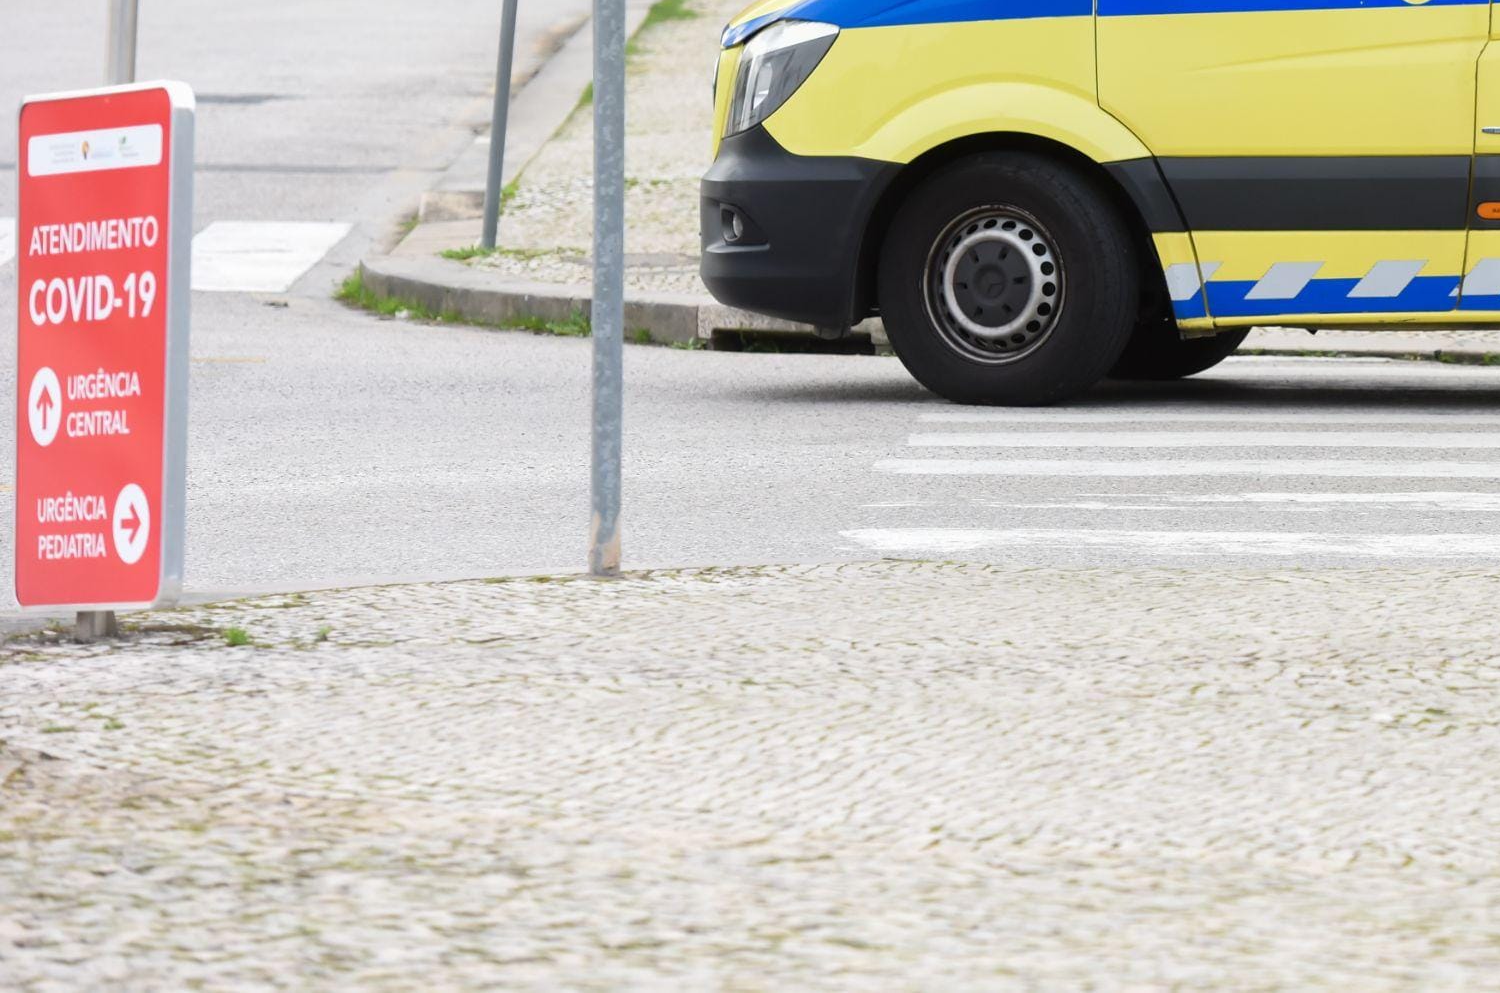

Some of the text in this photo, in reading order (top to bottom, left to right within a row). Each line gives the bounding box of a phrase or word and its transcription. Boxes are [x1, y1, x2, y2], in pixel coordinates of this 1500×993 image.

[28, 215, 159, 256] ATENDIMENTO
[28, 270, 157, 327] COVID-19
[67, 367, 141, 401] URGÊNCIA
[66, 410, 130, 438] CENTRAL
[37, 491, 108, 523] URGÊNCIA
[37, 532, 107, 560] PEDIATRIA
